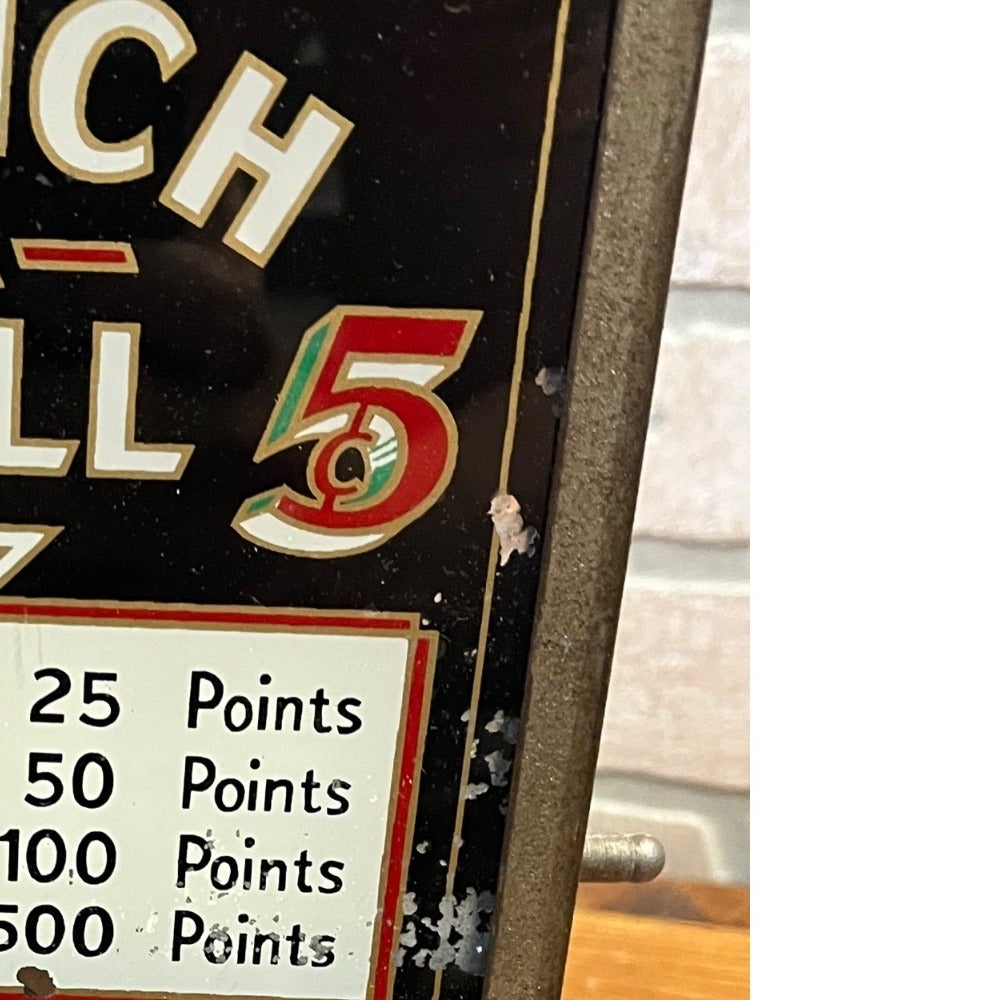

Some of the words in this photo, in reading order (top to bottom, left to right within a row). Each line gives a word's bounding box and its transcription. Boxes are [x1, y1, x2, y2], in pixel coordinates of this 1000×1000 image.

[29, 667, 121, 728] 25
[186, 670, 363, 735] Points
[23, 752, 115, 809] 50
[181, 755, 353, 816] Points
[176, 833, 345, 895] Points
[170, 909, 336, 968] Points
